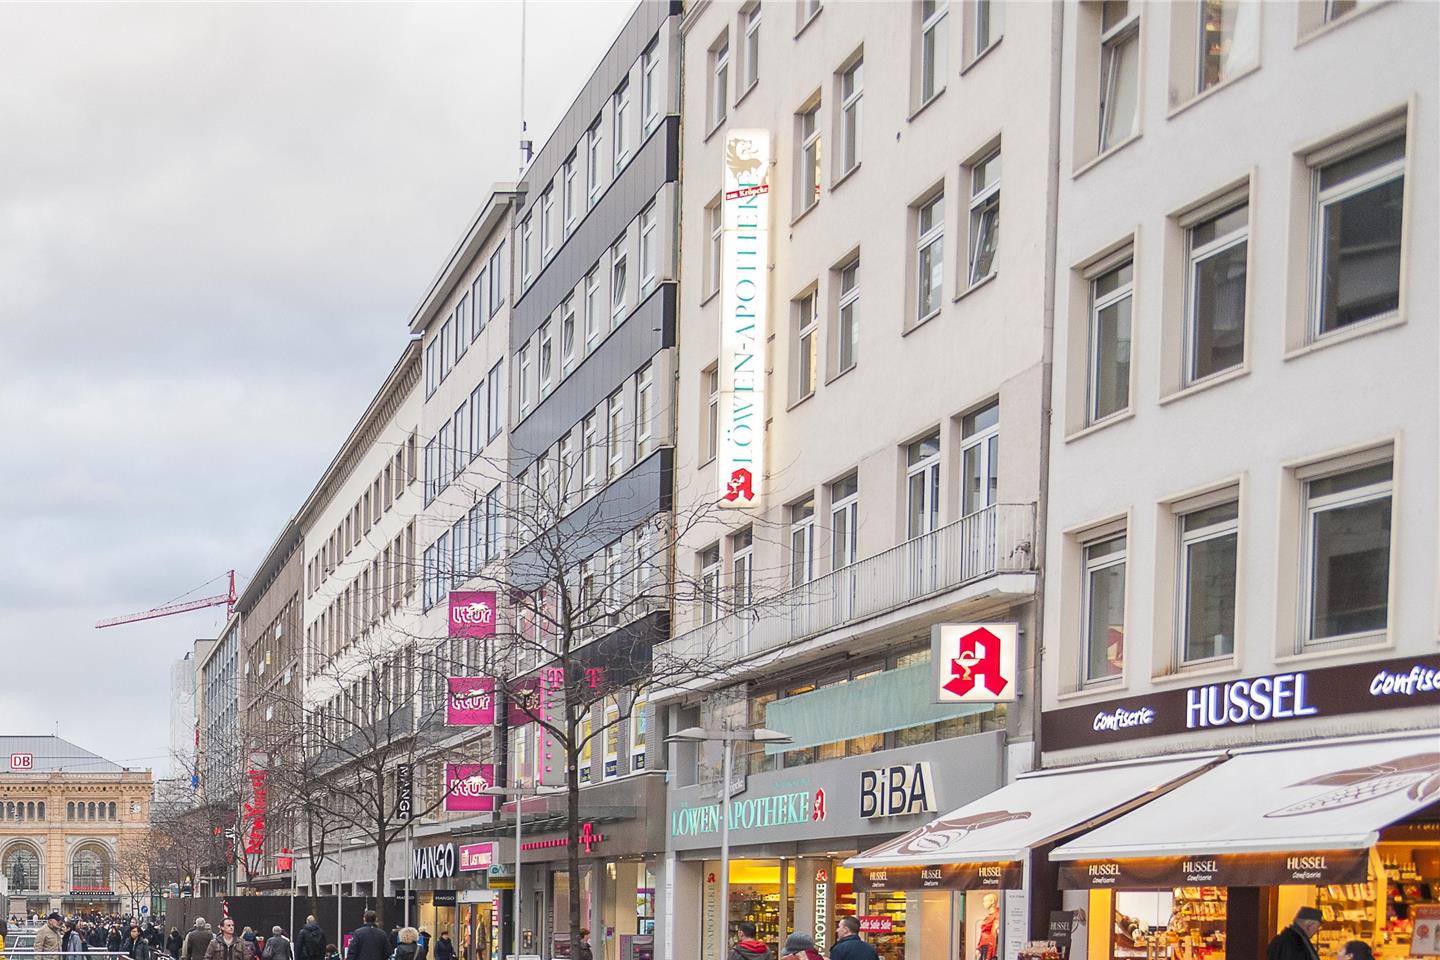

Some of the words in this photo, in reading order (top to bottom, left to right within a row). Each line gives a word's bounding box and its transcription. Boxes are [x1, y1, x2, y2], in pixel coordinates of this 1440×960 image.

[1093, 706, 1154, 731] Confiserie
[1186, 673, 1318, 729] HUSSEL
[13, 757, 31, 767] DB
[860, 762, 930, 818] BiBA
[412, 842, 455, 880] MANGO
[1183, 860, 1218, 873] HUSSEL
[1287, 856, 1328, 870] HUSSEL
[921, 869, 942, 880] HUSSEL
[978, 866, 1001, 877] HUSSEL
[1088, 863, 1121, 876] HUSSEL
[870, 871, 888, 881] HUSSEL
[870, 919, 880, 929] Sale
[880, 919, 891, 930] Sale
[1050, 921, 1071, 931] HUSSEL
